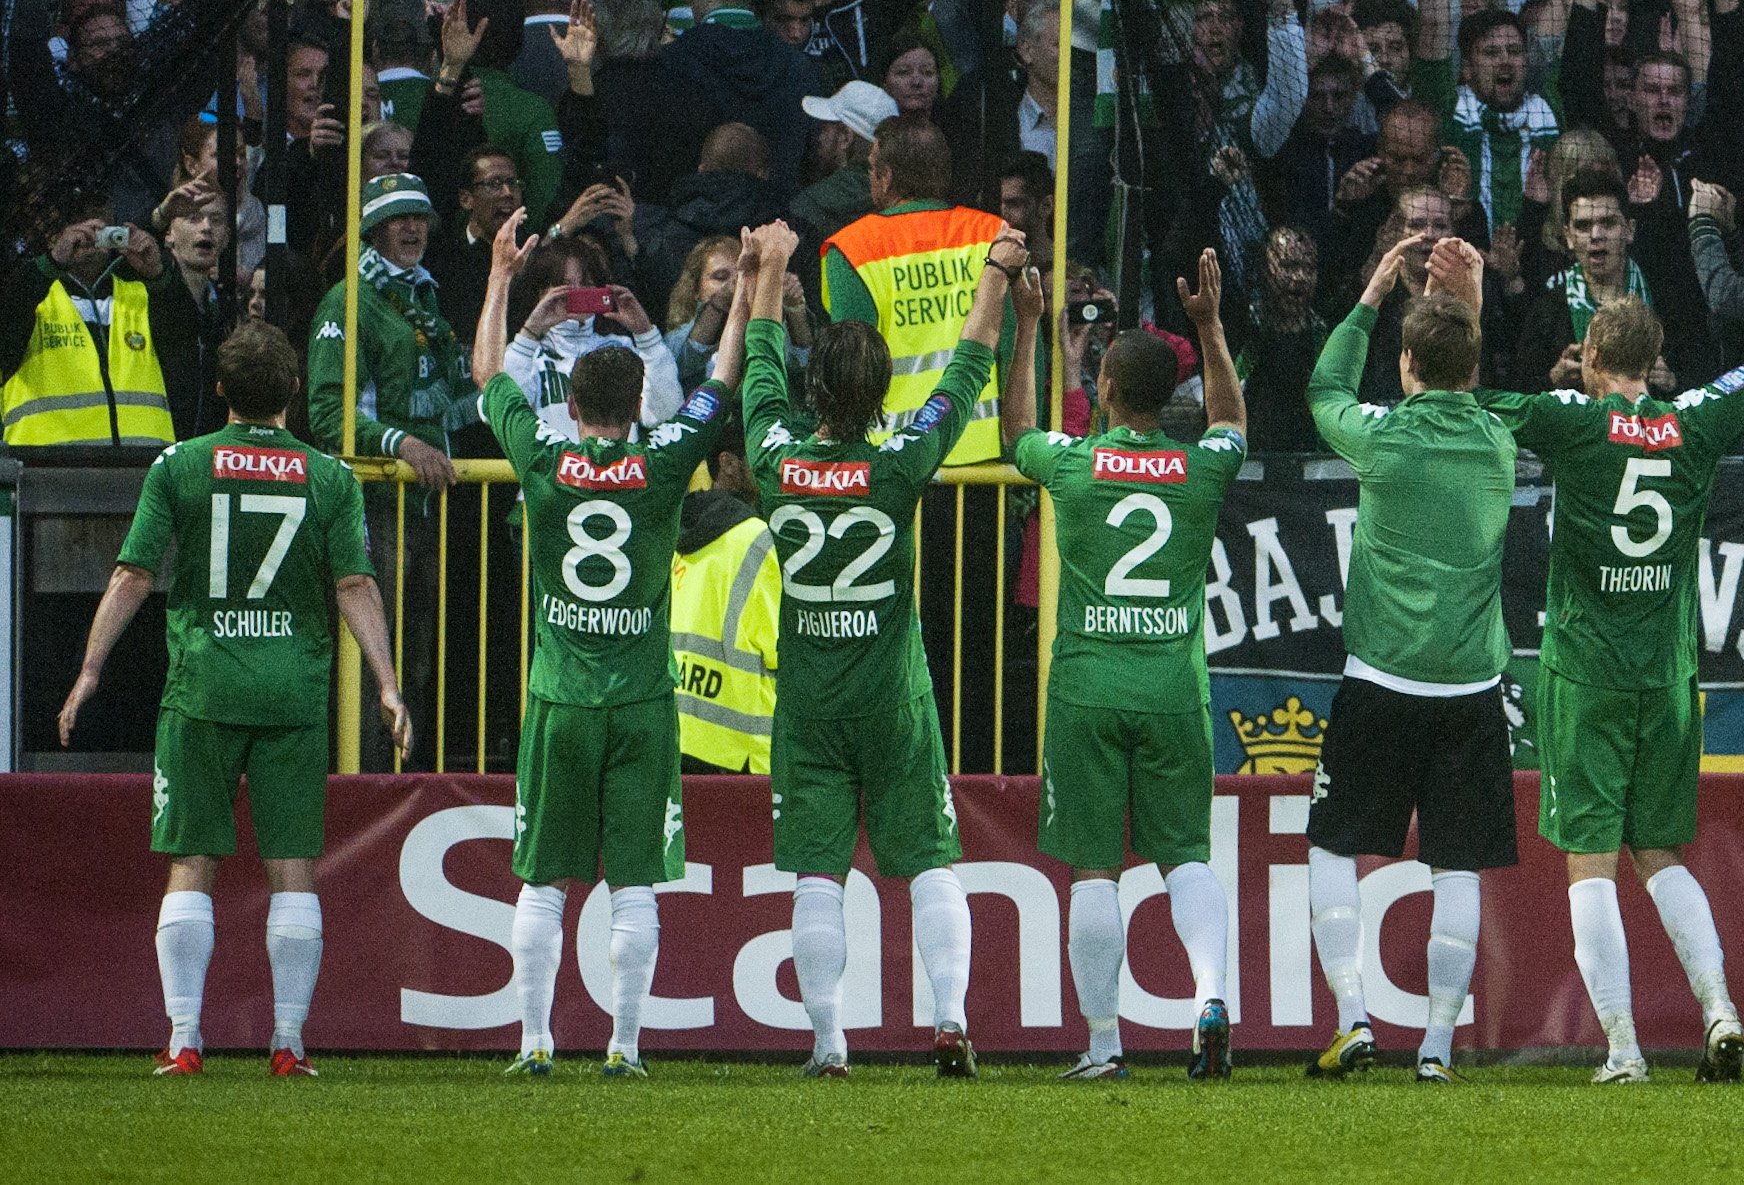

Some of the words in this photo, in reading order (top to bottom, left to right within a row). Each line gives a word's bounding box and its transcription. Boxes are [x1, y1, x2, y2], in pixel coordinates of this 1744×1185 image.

[893, 256, 973, 291] PUBLIK
[43, 322, 82, 334] PUBLIK
[43, 335, 87, 349] SERVICE
[215, 449, 304, 475] FOLKIA
[559, 455, 645, 484] FOLKIA
[782, 463, 867, 490] FOLKIA
[1096, 452, 1184, 477] FOLKIA
[1610, 457, 1673, 558] 5
[209, 493, 307, 599] 17
[562, 499, 633, 602] 8
[769, 504, 895, 602] 22
[1105, 492, 1173, 597] 2
[1600, 565, 1672, 593] THEORIN
[213, 610, 293, 638] SCHULER
[797, 610, 879, 638] FIGUEROA
[1084, 604, 1189, 635] BERNTSSON
[398, 794, 1475, 1031] Scandic
